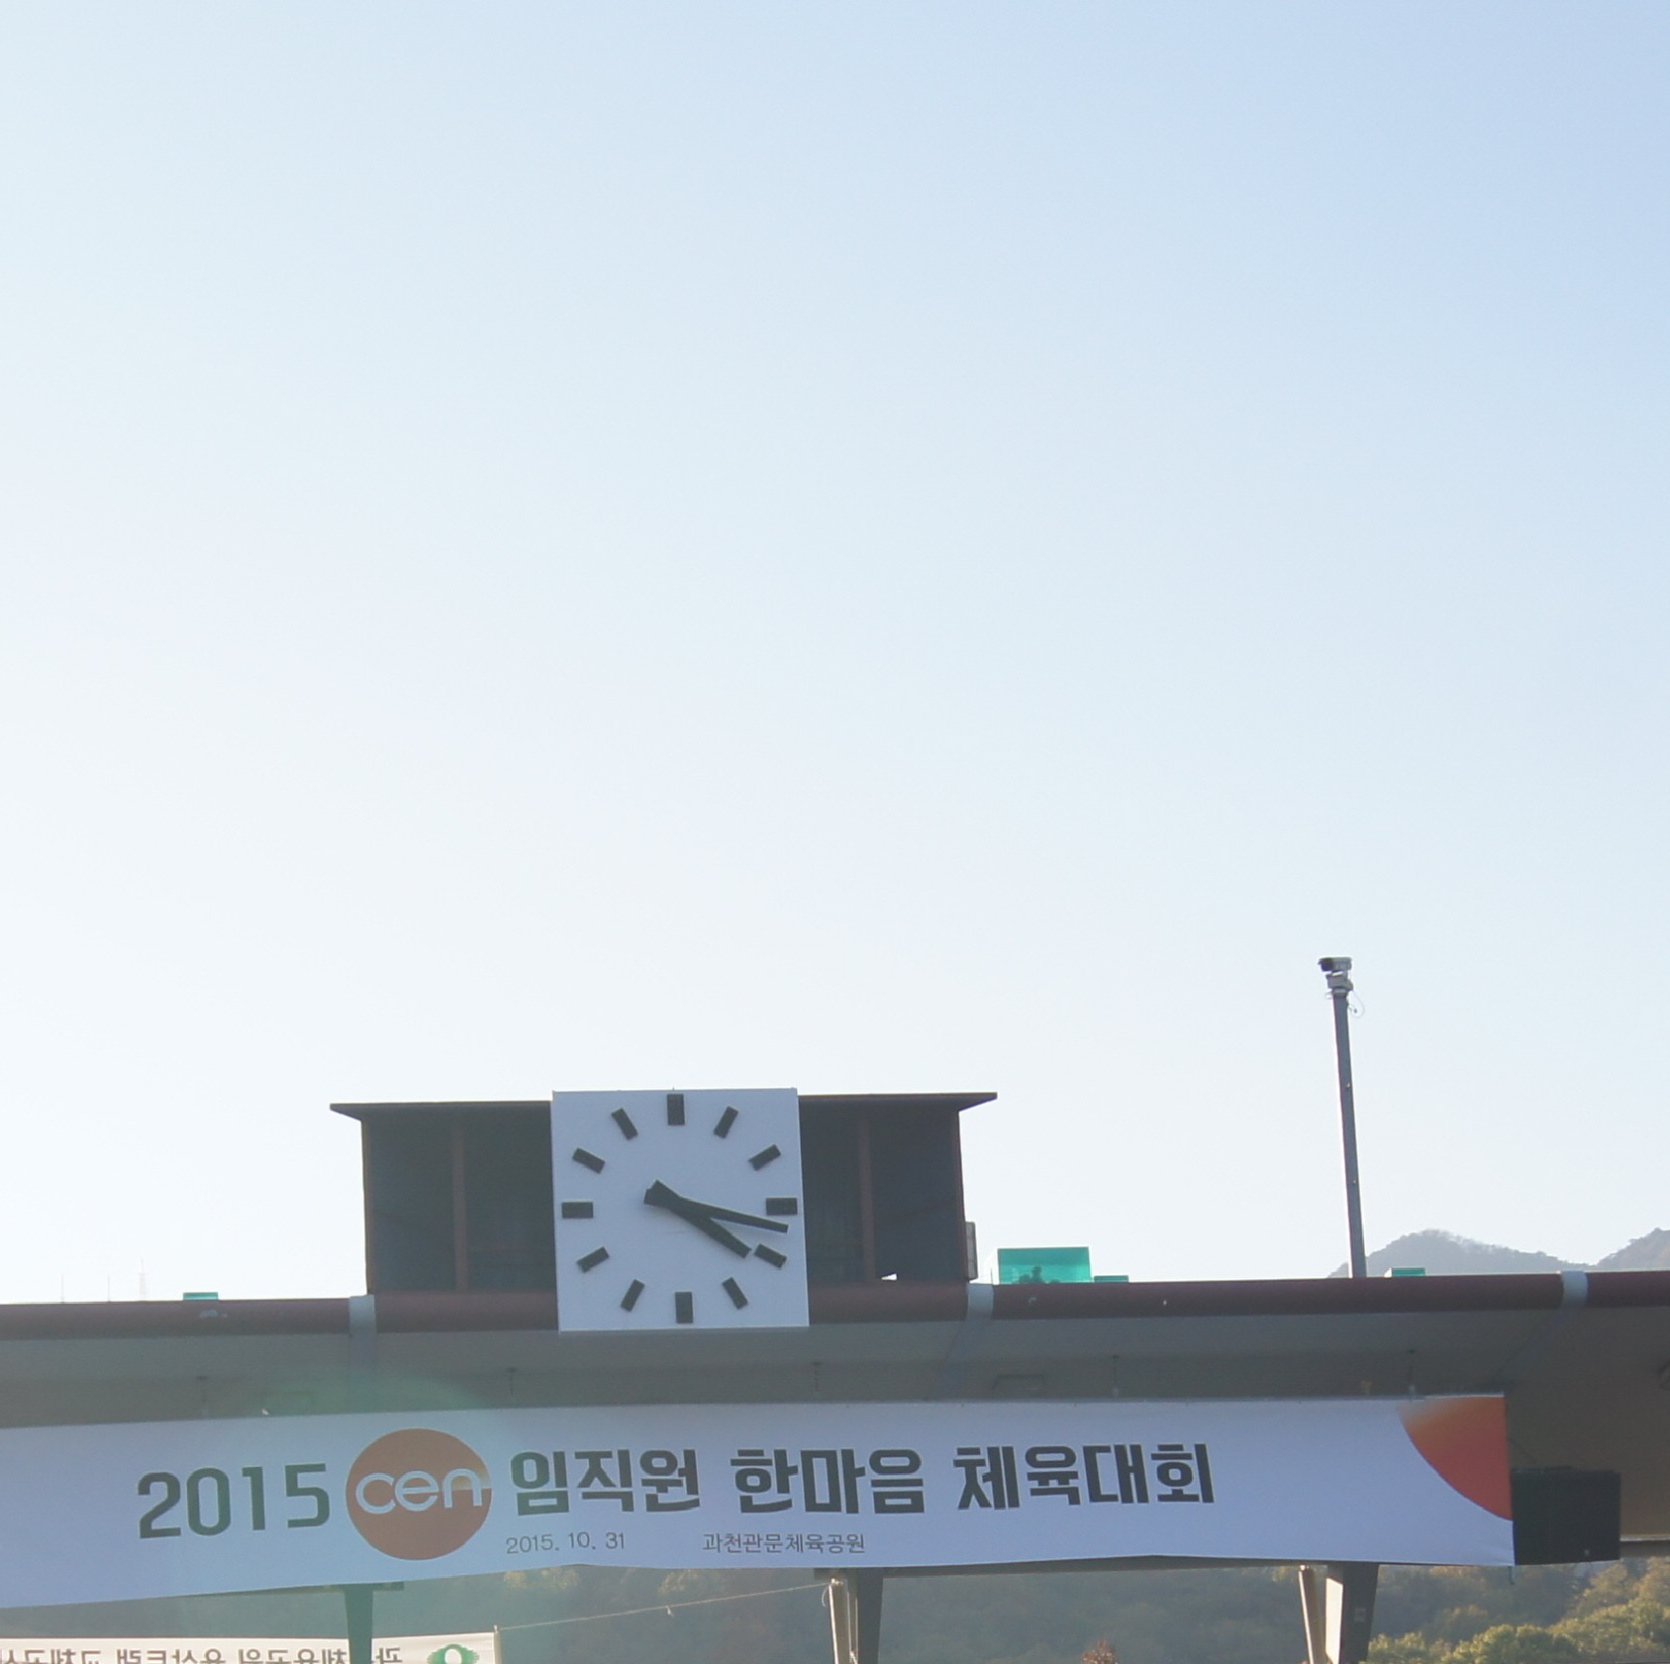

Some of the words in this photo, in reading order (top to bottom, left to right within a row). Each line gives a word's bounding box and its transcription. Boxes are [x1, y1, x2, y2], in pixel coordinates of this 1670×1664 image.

[137, 1462, 330, 1540] 2015
[355, 1466, 485, 1513] cen
[509, 1447, 702, 1518] 임직원
[729, 1445, 926, 1517] 한마음
[953, 1440, 1216, 1513] 체육대회
[702, 1530, 866, 1556] 과천관문체육공원
